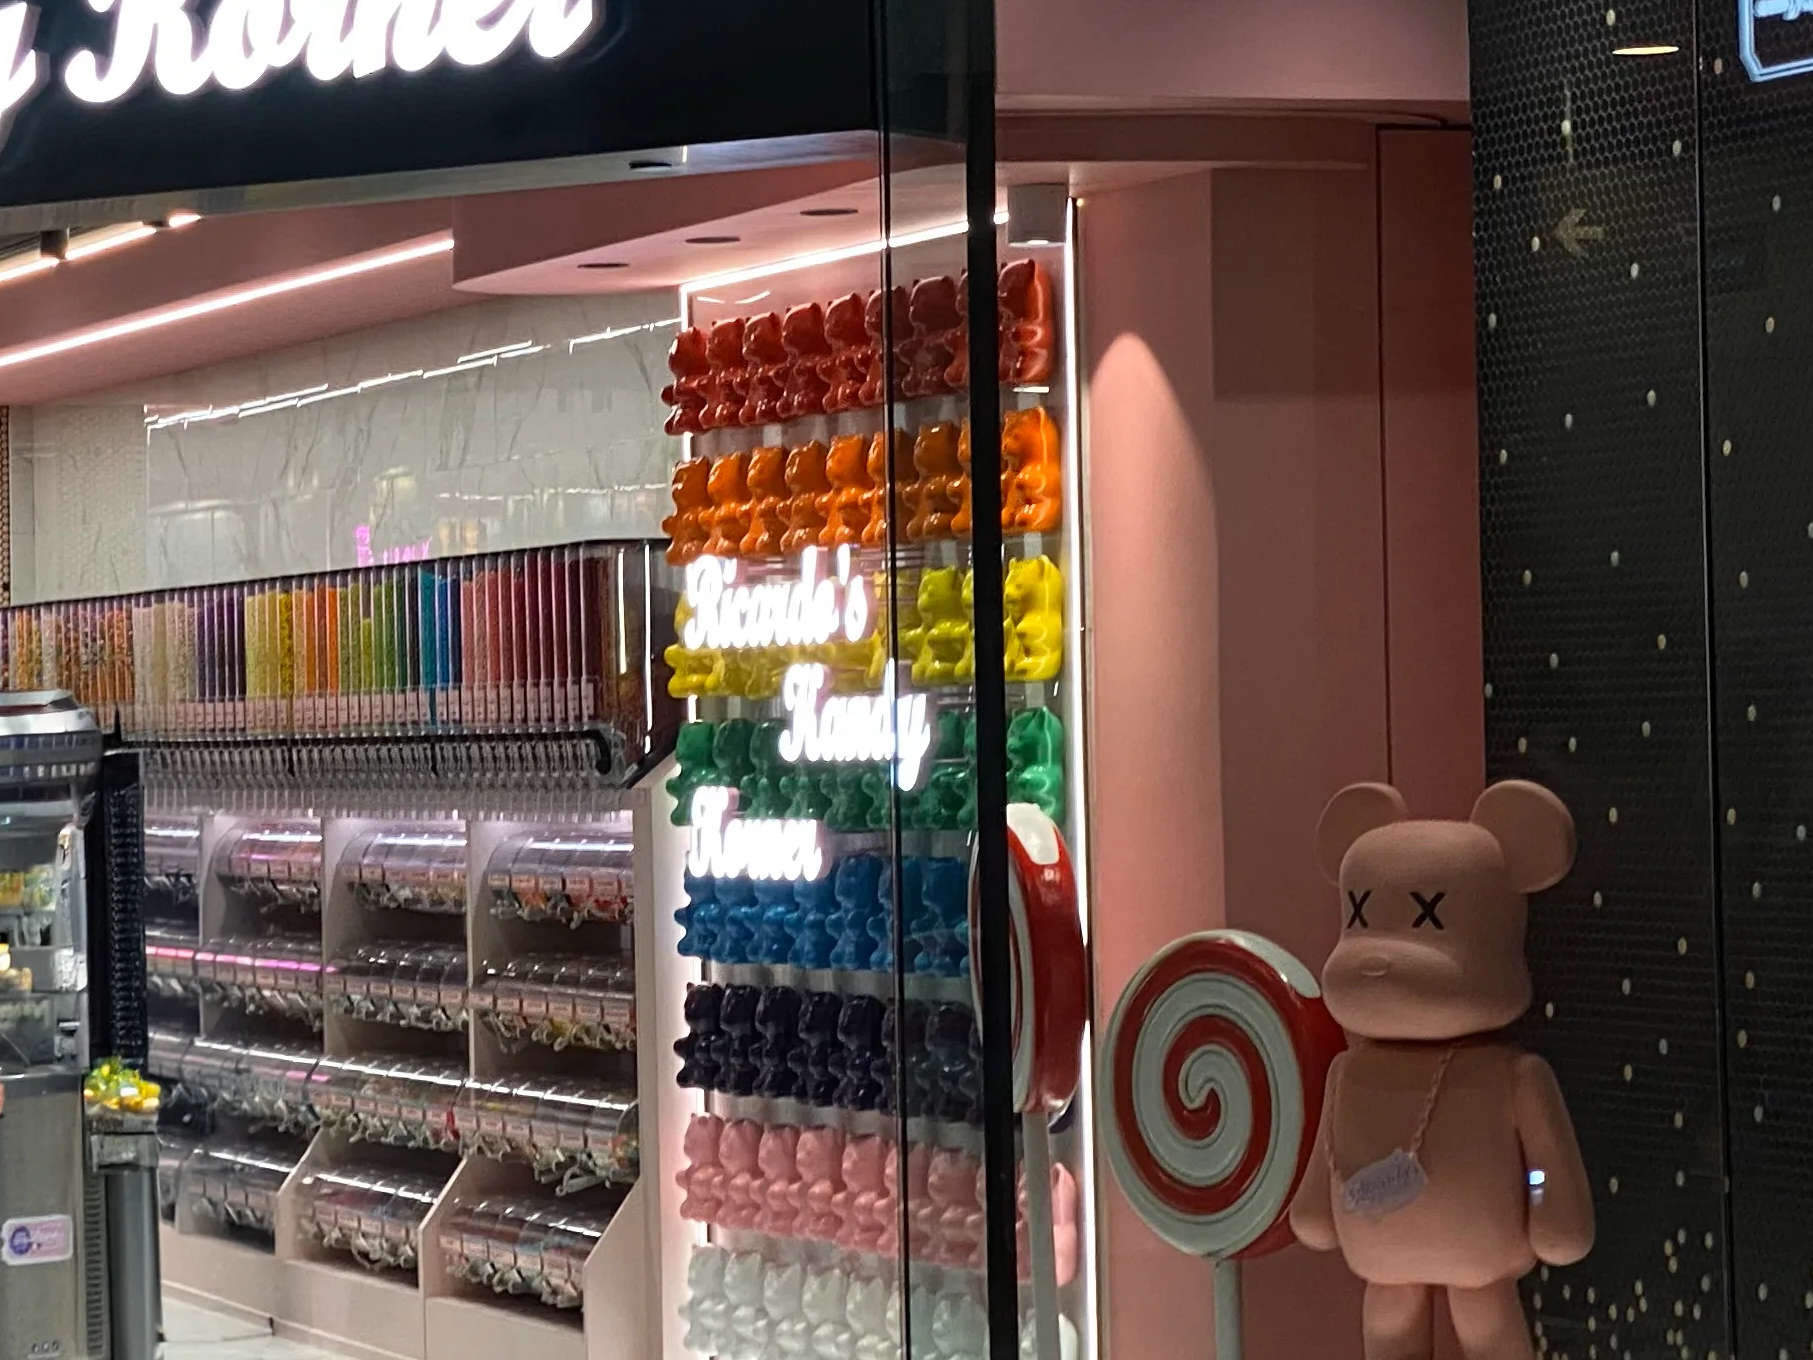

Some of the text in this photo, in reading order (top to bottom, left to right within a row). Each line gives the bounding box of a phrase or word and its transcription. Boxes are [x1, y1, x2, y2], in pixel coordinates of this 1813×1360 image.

[683, 544, 869, 650] Ricardo's
[779, 657, 931, 792] Kandy
[688, 785, 823, 881] Korner
